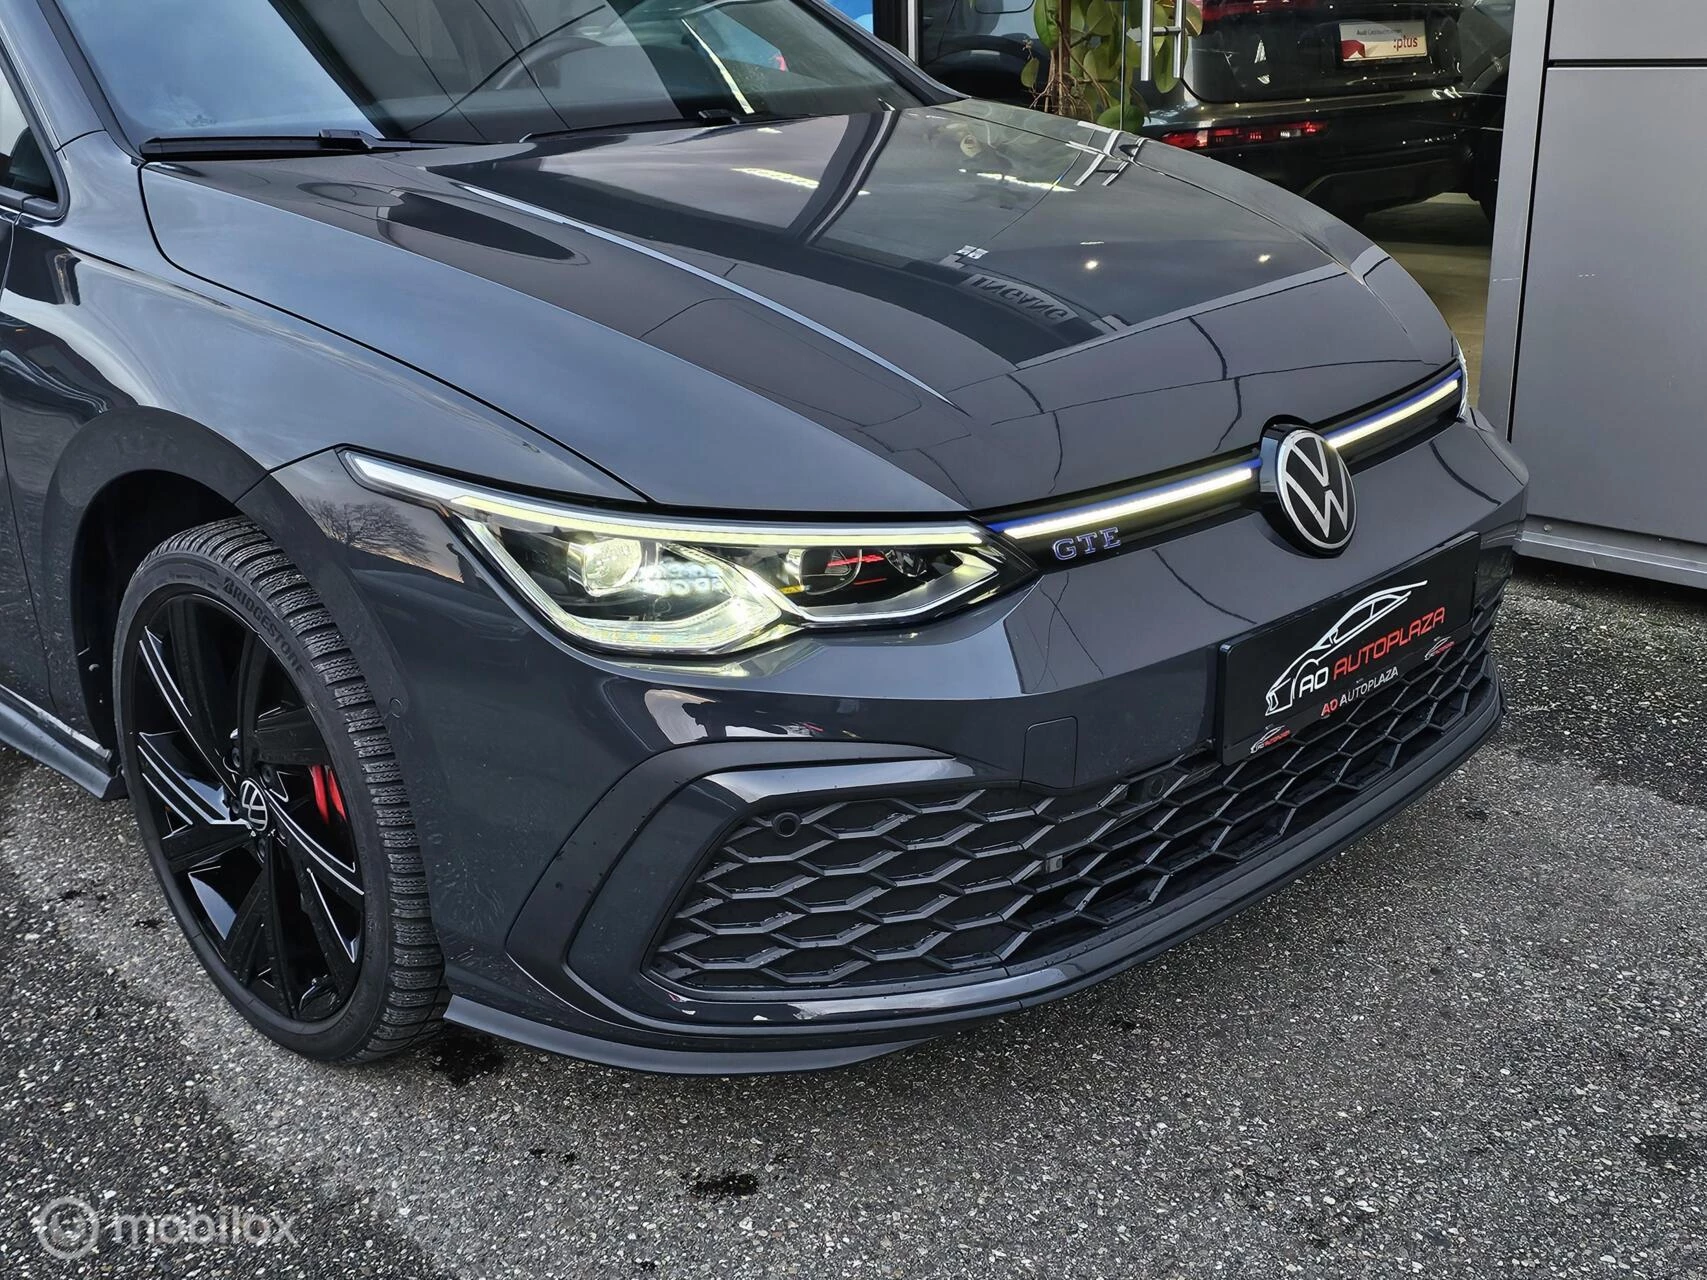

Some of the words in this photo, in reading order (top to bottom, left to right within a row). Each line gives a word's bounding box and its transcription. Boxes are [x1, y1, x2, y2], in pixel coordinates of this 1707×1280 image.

[1052, 526, 1121, 560] GTE
[223, 576, 306, 674] BRIDGESTONE
[1299, 667, 1329, 698] AO
[1333, 607, 1445, 680] AUTOPLAZA
[1321, 698, 1338, 716] AO
[1339, 666, 1399, 707] AUTOPLAZA
